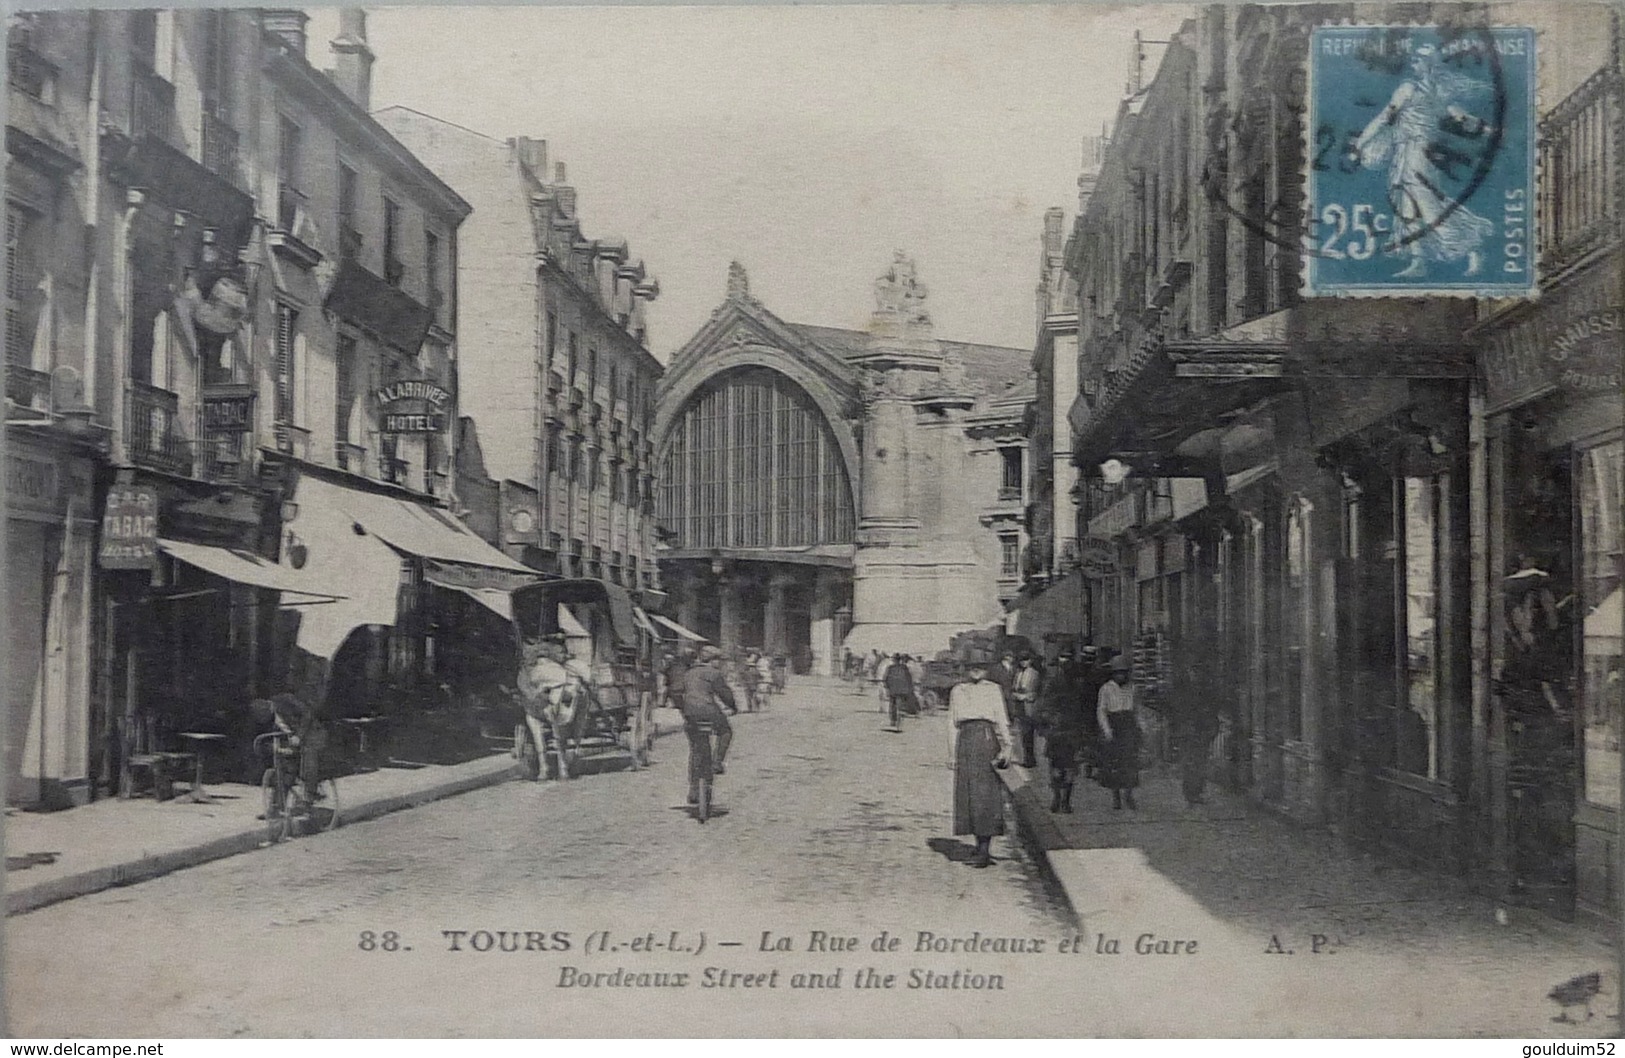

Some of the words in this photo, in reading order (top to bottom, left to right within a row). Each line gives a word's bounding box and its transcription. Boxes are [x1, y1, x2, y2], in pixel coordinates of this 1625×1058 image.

[1504, 187, 1526, 274] POSTES
[386, 415, 438, 431] HOTEL
[103, 515, 156, 538] TABAC
[358, 930, 412, 952] 88.
[441, 930, 572, 952] TOURS
[758, 930, 792, 952] La
[807, 930, 859, 952] Rue
[870, 930, 900, 952] de
[914, 931, 1045, 954] Bordeaux
[1057, 934, 1084, 954] et
[1095, 933, 1120, 954] la
[1134, 934, 1198, 955] Gare
[1264, 934, 1295, 955] A.
[1311, 933, 1337, 955] P.
[556, 966, 689, 989] Bordeaux
[701, 967, 779, 989] Street
[790, 967, 842, 989] and
[855, 967, 895, 989] the
[907, 968, 1004, 990] Station
